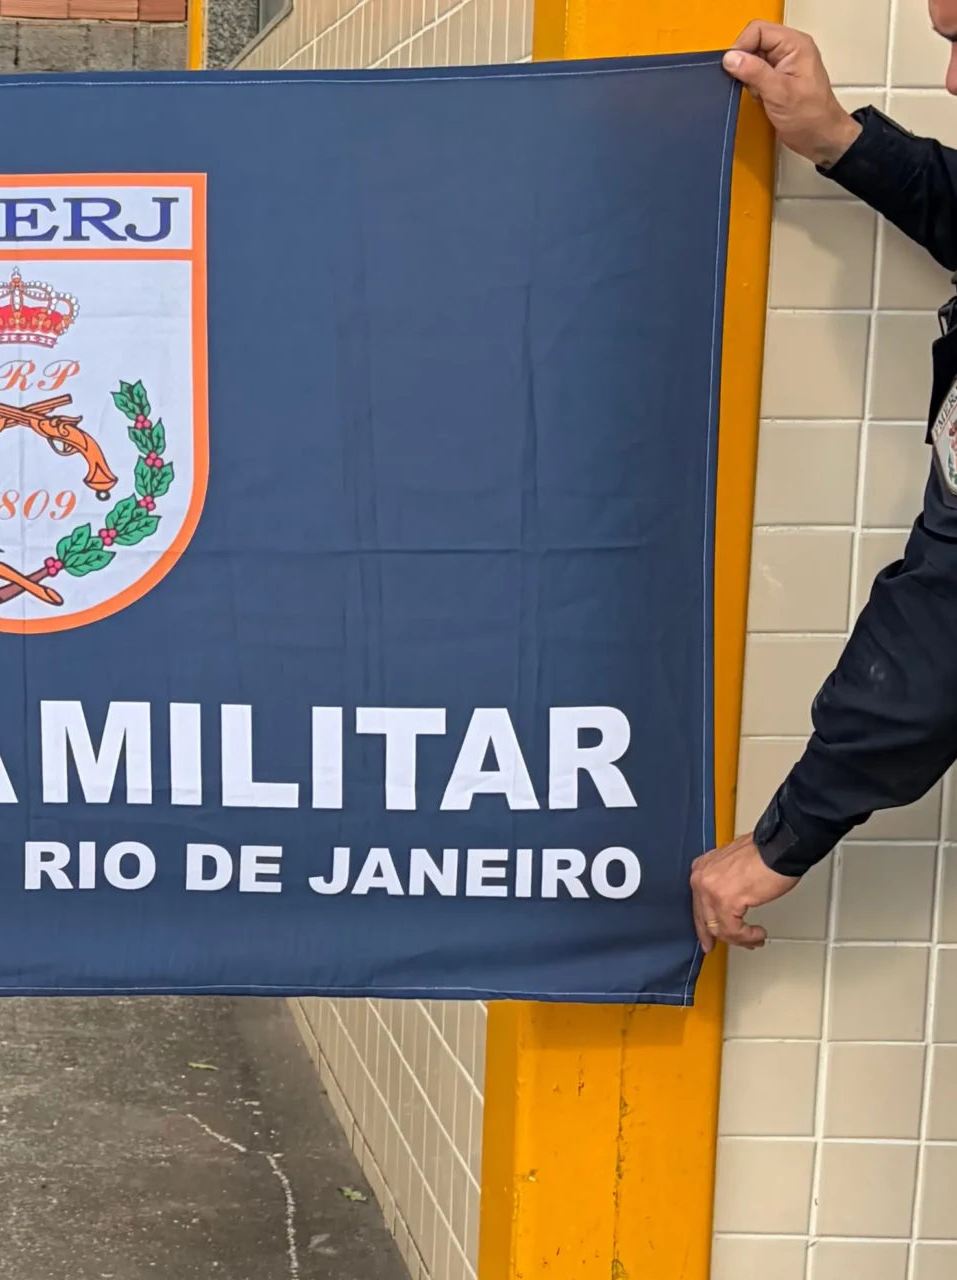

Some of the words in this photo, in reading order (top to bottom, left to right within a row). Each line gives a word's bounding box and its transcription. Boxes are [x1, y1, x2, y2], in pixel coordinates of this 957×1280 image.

[40, 700, 638, 810] MILITAR
[24, 841, 156, 890] RIO
[186, 843, 283, 892] DE
[308, 846, 641, 899] JANEIRO
